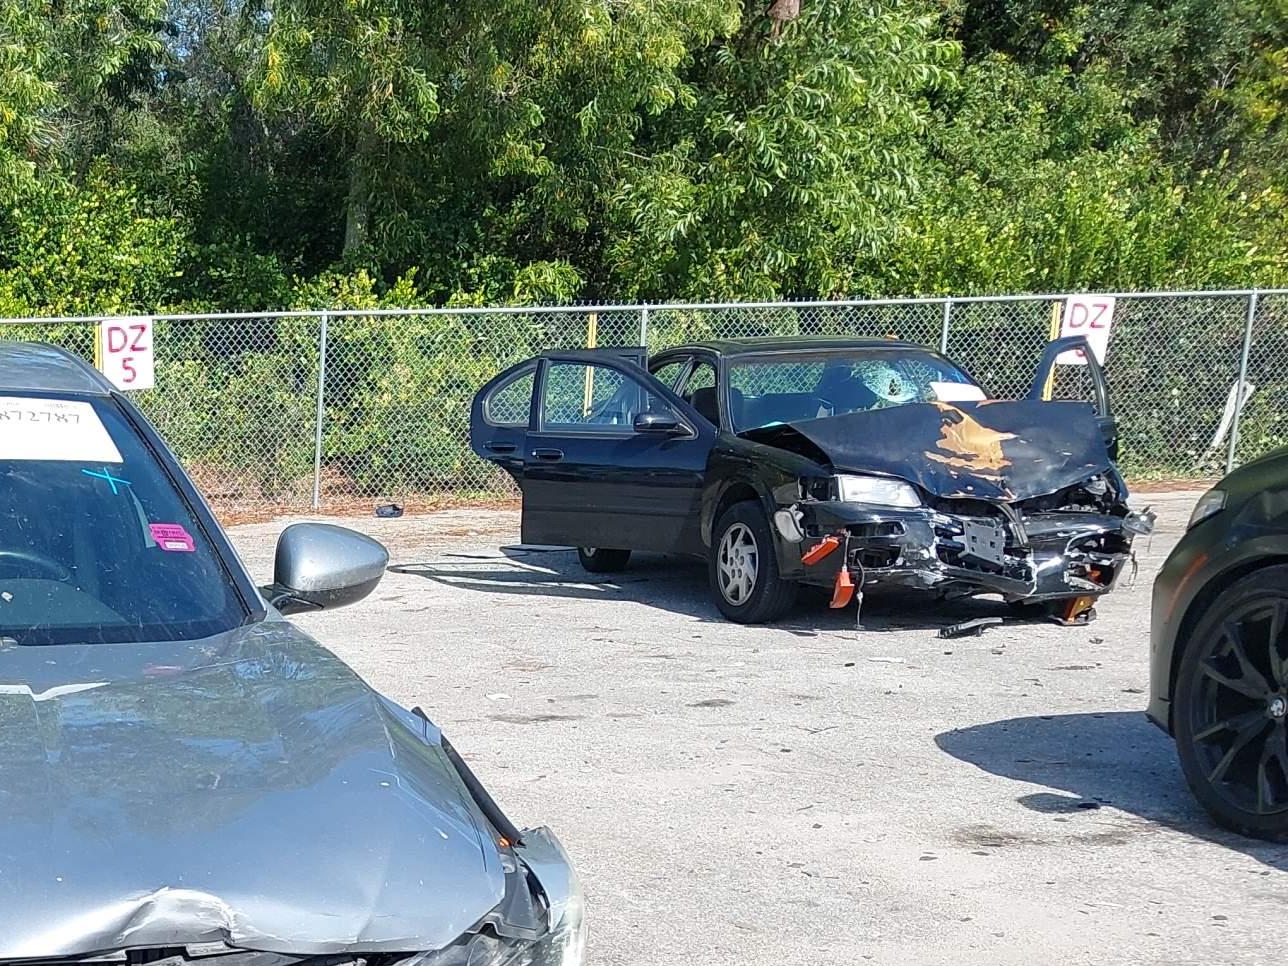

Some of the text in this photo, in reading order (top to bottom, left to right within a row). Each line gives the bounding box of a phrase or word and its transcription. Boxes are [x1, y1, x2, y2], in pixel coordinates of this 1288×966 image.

[1069, 303, 1109, 328] DZ
[107, 324, 148, 353] DZ
[122, 357, 137, 383] 5
